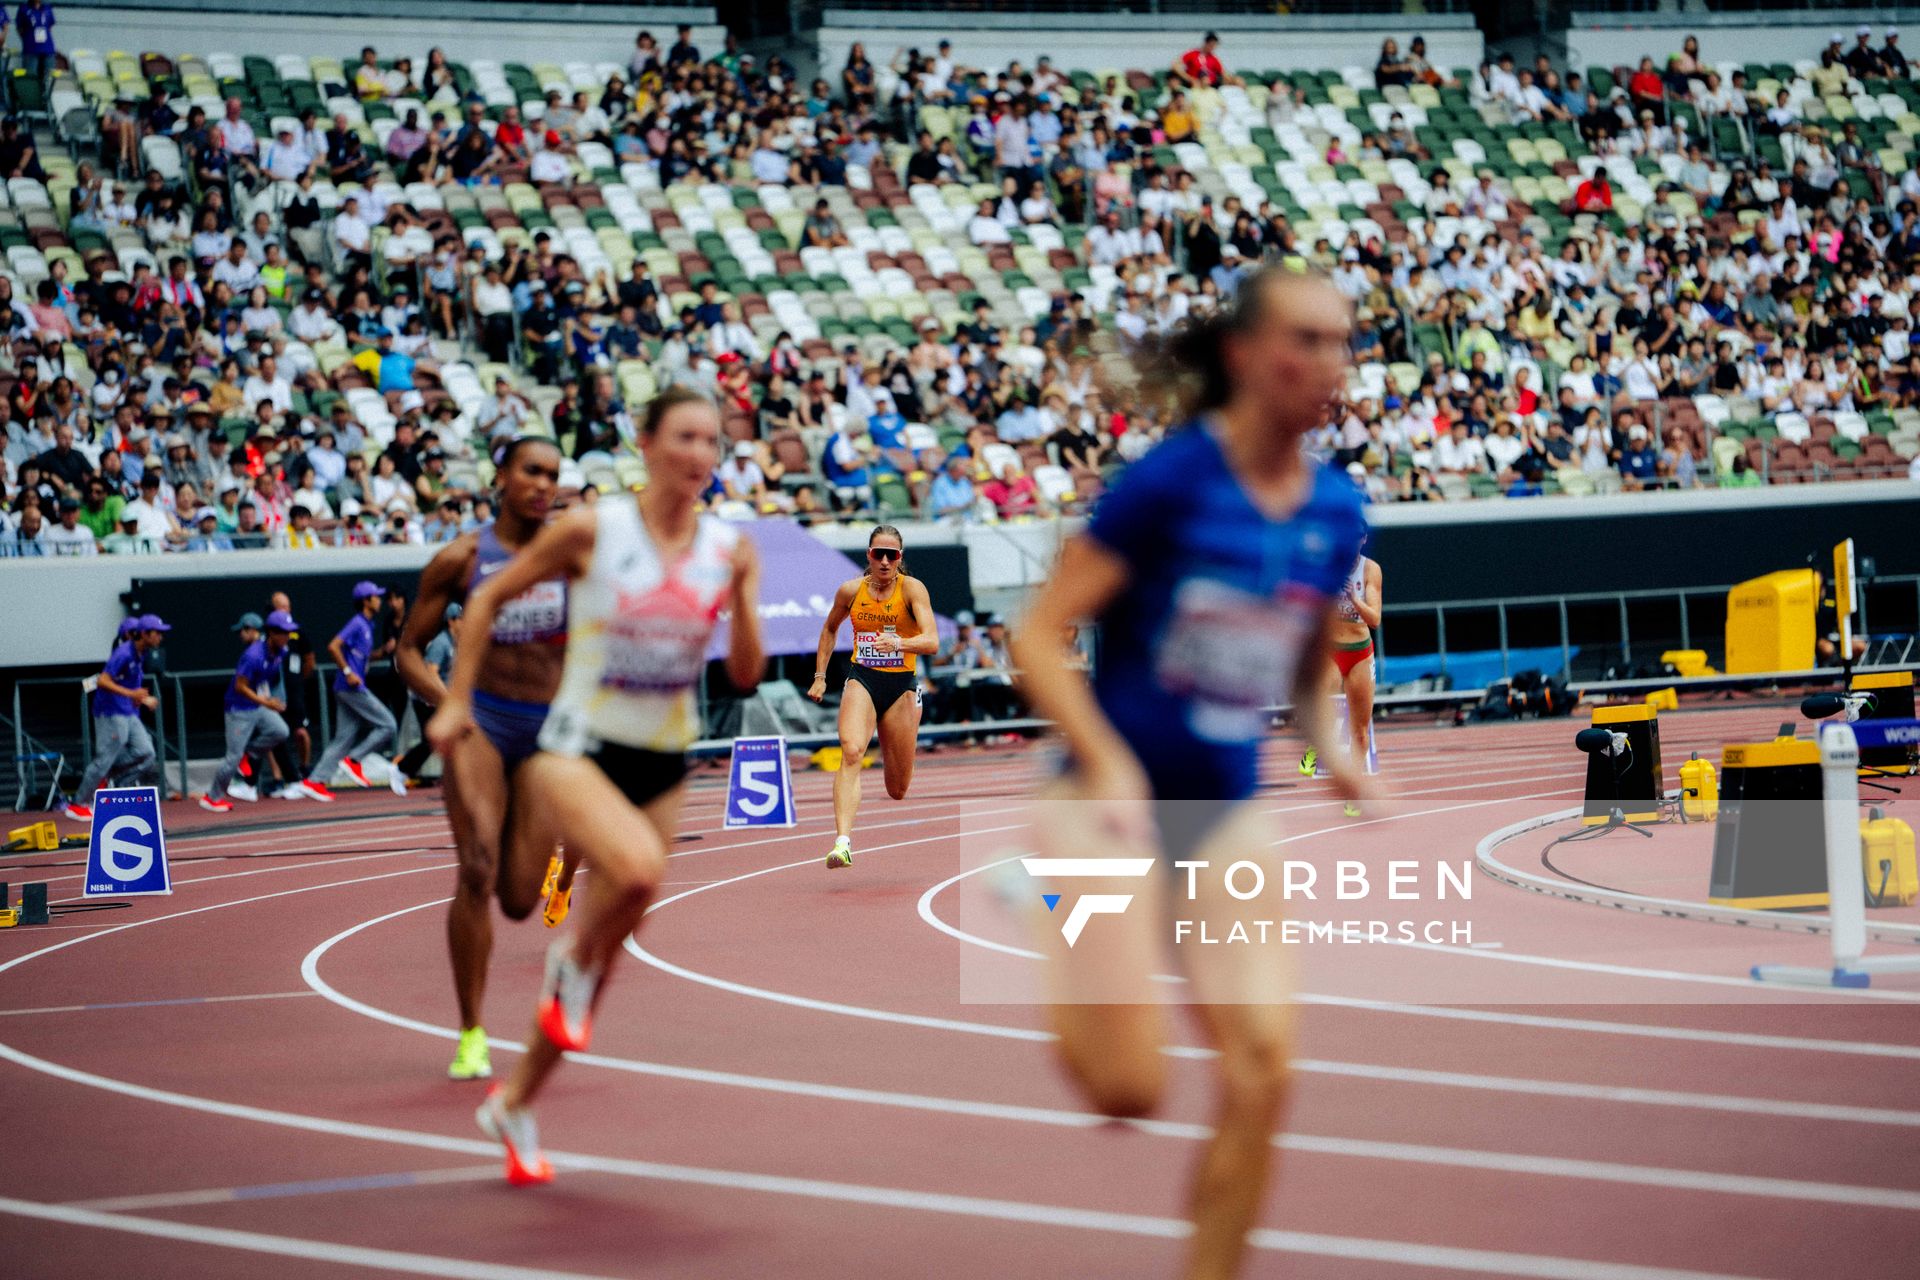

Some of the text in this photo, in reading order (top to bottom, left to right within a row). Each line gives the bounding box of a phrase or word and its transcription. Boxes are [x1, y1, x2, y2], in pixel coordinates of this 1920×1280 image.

[857, 611, 899, 623] GERMANY
[737, 760, 779, 817] 5
[100, 815, 153, 881] 6
[90, 884, 113, 892] NISHI
